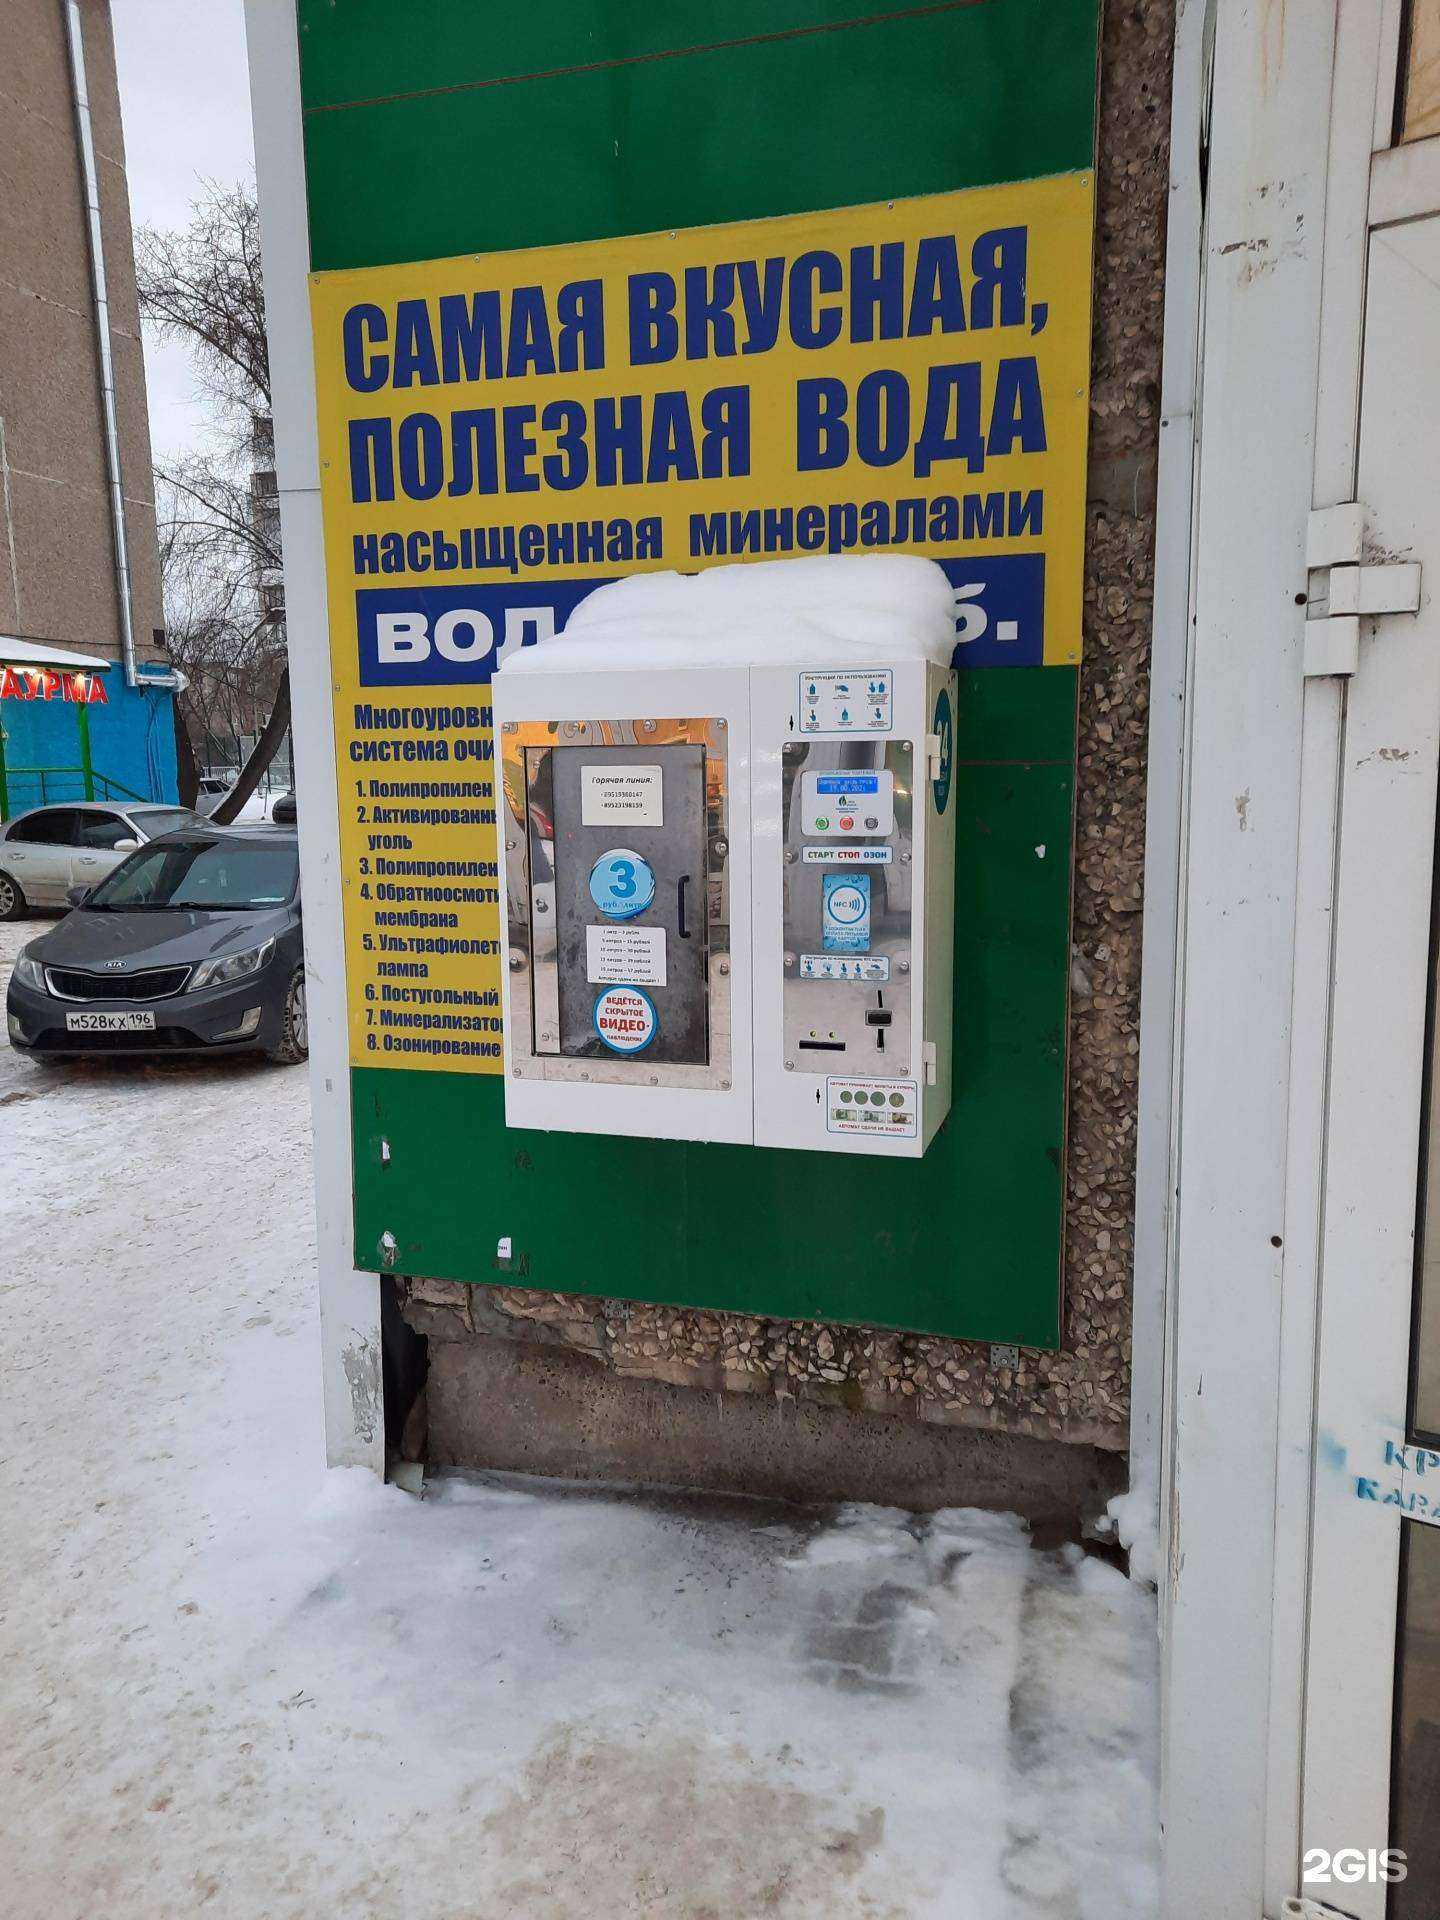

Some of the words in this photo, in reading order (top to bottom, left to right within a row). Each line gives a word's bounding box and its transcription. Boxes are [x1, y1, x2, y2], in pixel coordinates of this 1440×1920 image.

[343, 279, 605, 393] САМАЯ
[628, 226, 1048, 366] ВКУСНАЯ,
[349, 385, 750, 503] ПОЛЕЗНАЯ
[797, 356, 1047, 478] ВОДА
[352, 516, 662, 575] насыщенная
[690, 489, 1043, 557] минералами
[0, 665, 108, 704] АУРМА
[350, 739, 448, 762] система
[356, 780, 367, 797] 1.
[370, 780, 492, 799] Полипропилен
[357, 807, 370, 824] 2.
[368, 833, 413, 850] уголь
[808, 851, 834, 859] СТАРТ
[359, 857, 373, 874] 3.
[376, 858, 498, 877] Полипропилен
[609, 860, 637, 898] 3
[360, 884, 373, 900] 4.
[375, 911, 458, 928] мембрана
[363, 934, 376, 951] 5.
[379, 934, 500, 954] Ультрафиолет
[377, 961, 428, 977] лампа
[365, 984, 378, 1001] 6.
[381, 984, 499, 1006] Постугольный
[606, 996, 643, 1006] ВЕДЁТСЯ
[70, 1015, 127, 1029] М528КХ
[129, 1013, 151, 1024] 196
[366, 1009, 377, 1025] 7.
[380, 1010, 503, 1032] Минерализато
[605, 1007, 644, 1017] СКРЫТОЕ
[367, 1034, 379, 1050] 8.
[383, 1035, 500, 1058] Озонирование
